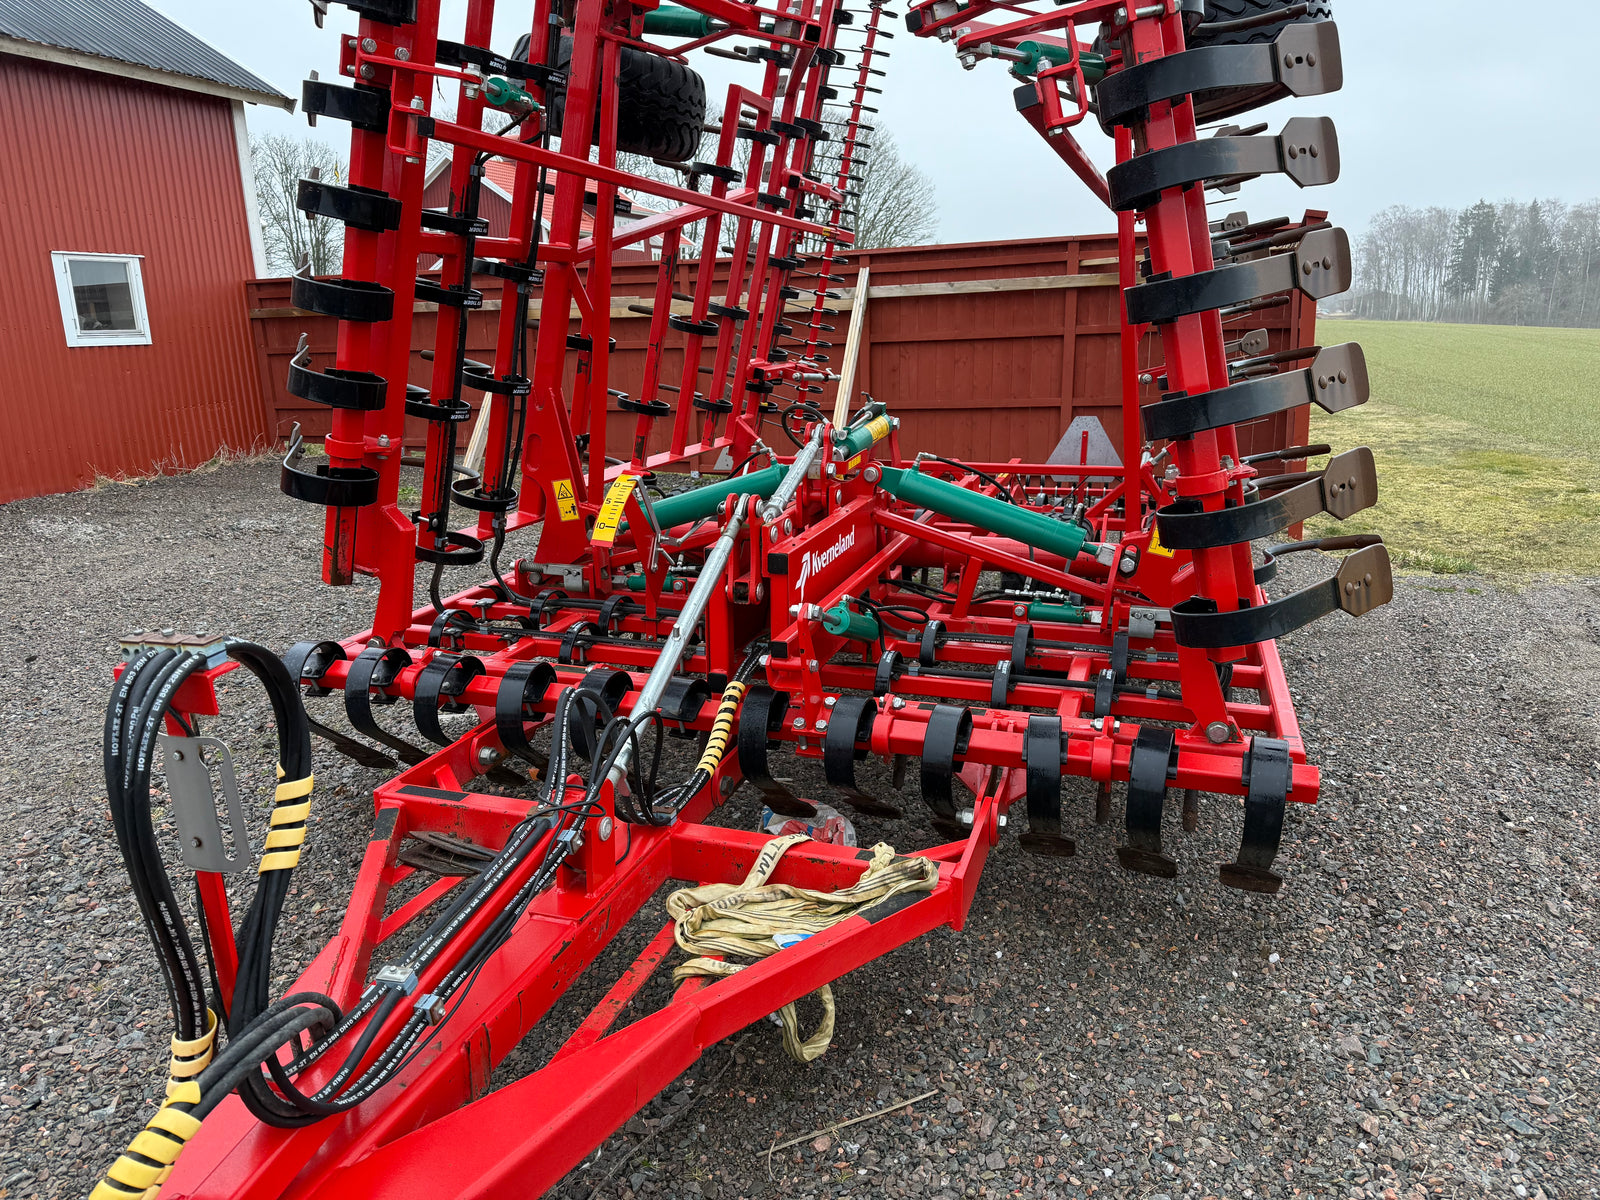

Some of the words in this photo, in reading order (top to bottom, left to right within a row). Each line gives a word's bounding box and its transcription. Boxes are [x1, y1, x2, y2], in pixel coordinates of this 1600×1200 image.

[489, 61, 502, 70] TIGER
[548, 75, 561, 83] TIGER
[812, 524, 855, 576] Kverneland
[124, 672, 136, 686] 853
[153, 698, 163, 712] EN
[160, 684, 170, 698] 853
[183, 658, 194, 669] DN
[120, 685, 129, 698] EN
[757, 843, 784, 876] WLL
[184, 969, 193, 981] SAE
[309, 1050, 318, 1060] EN
[318, 1043, 329, 1053] 853
[327, 1032, 339, 1043] 2SN
[339, 1019, 354, 1033] DN10
[352, 1009, 363, 1022] WP
[362, 1002, 371, 1013] 330
[370, 995, 379, 1005] bar
